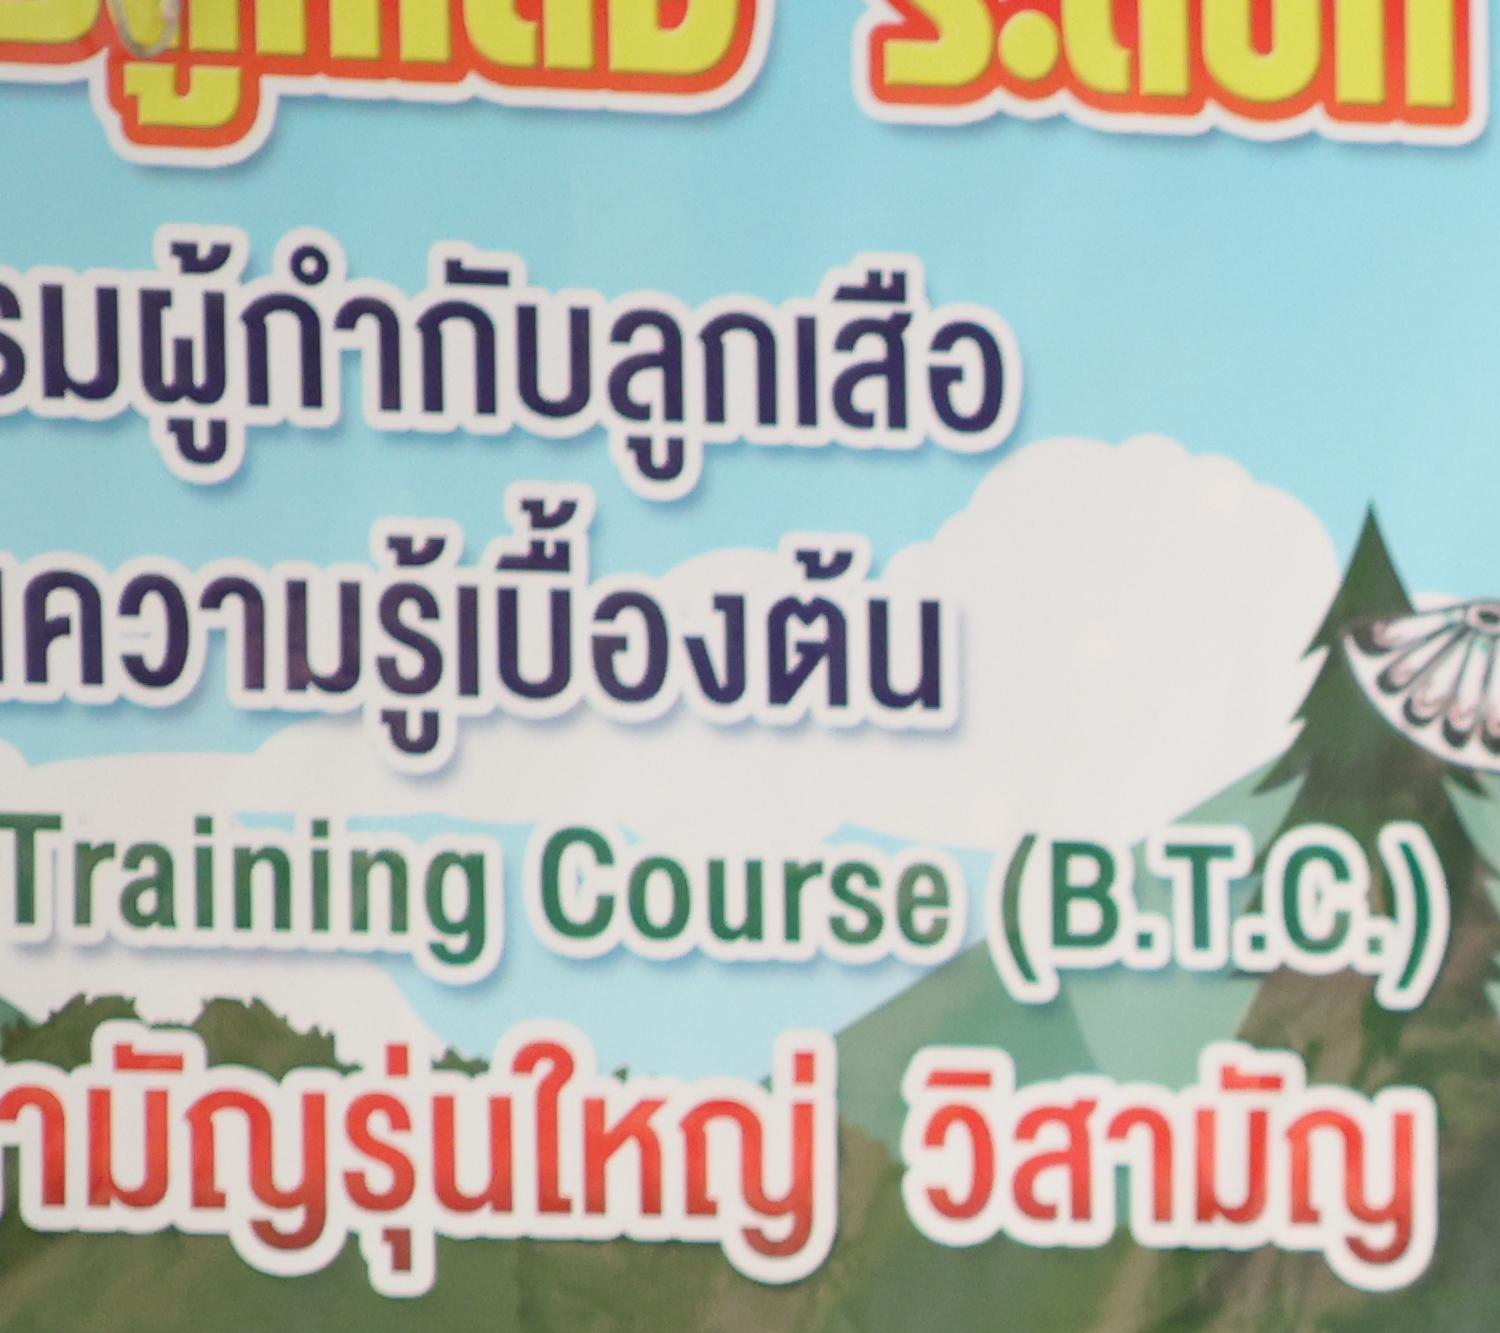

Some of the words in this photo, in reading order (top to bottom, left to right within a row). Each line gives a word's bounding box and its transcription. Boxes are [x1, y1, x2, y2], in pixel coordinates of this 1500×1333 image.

[0, 499, 942, 755] ความรู้เบื้องต้น
[0, 813, 487, 966] Training
[540, 826, 951, 948] Course
[1000, 833, 1429, 989] (B.T.C.)
[923, 1065, 1414, 1264] วิสามัญ
